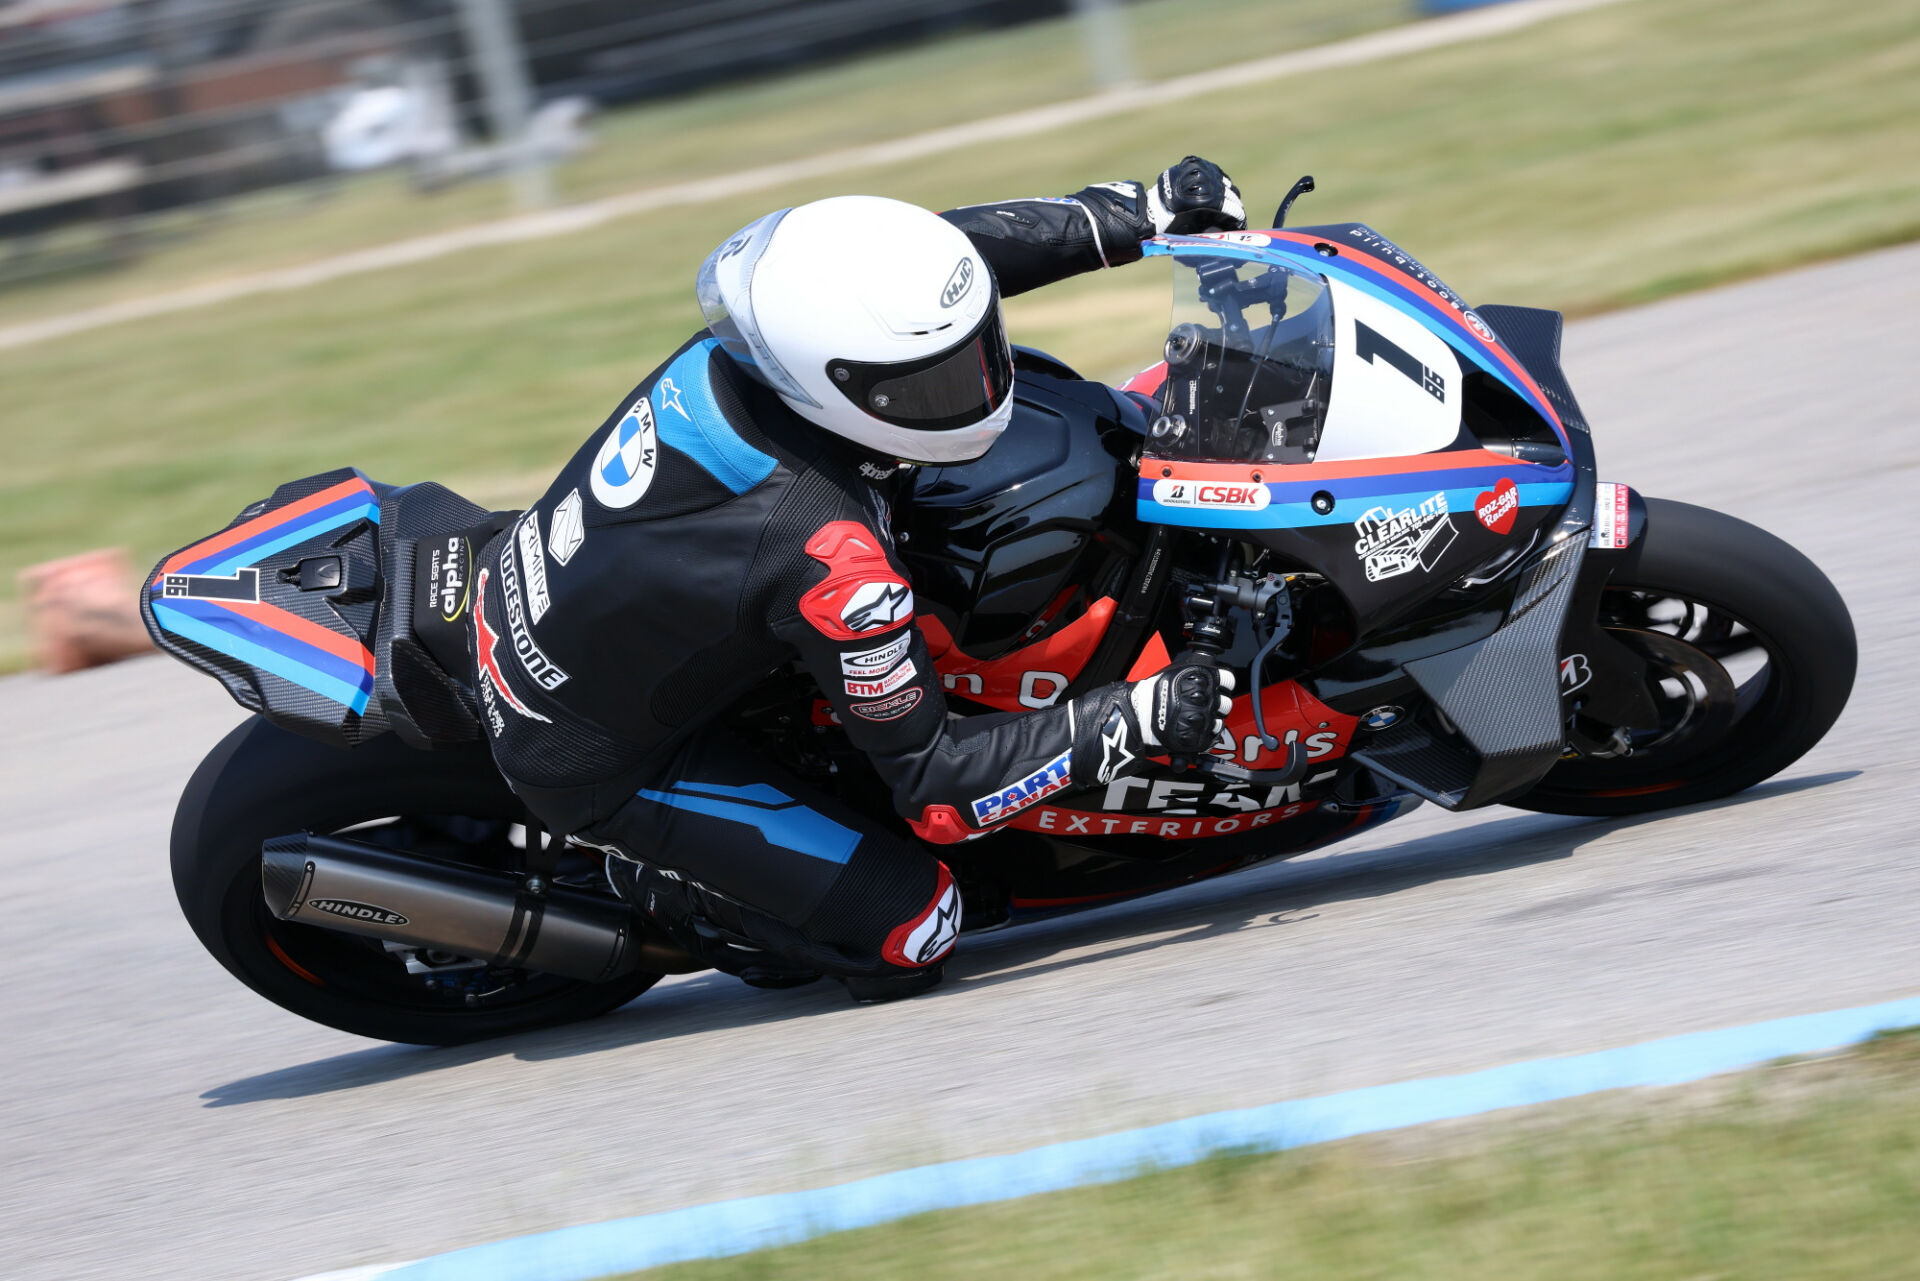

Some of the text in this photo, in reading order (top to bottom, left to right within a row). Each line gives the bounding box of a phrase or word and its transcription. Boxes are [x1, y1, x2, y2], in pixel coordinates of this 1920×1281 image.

[946, 261, 971, 303] HJC
[1354, 318, 1424, 388] 1
[1198, 486, 1260, 504] CSBK
[1478, 486, 1518, 519] ROZ-GAR
[1484, 496, 1518, 527] Racing
[1354, 491, 1448, 555] CLEARLITE
[187, 567, 260, 604] 1
[429, 549, 440, 608] RACE SEATS
[441, 537, 463, 613] alpha
[502, 541, 566, 687] IDGESTONE
[864, 643, 903, 664] HINDLE
[847, 681, 884, 695] BTM
[1038, 804, 1300, 836] EXTERIORS
[317, 901, 400, 924] HINDLE
